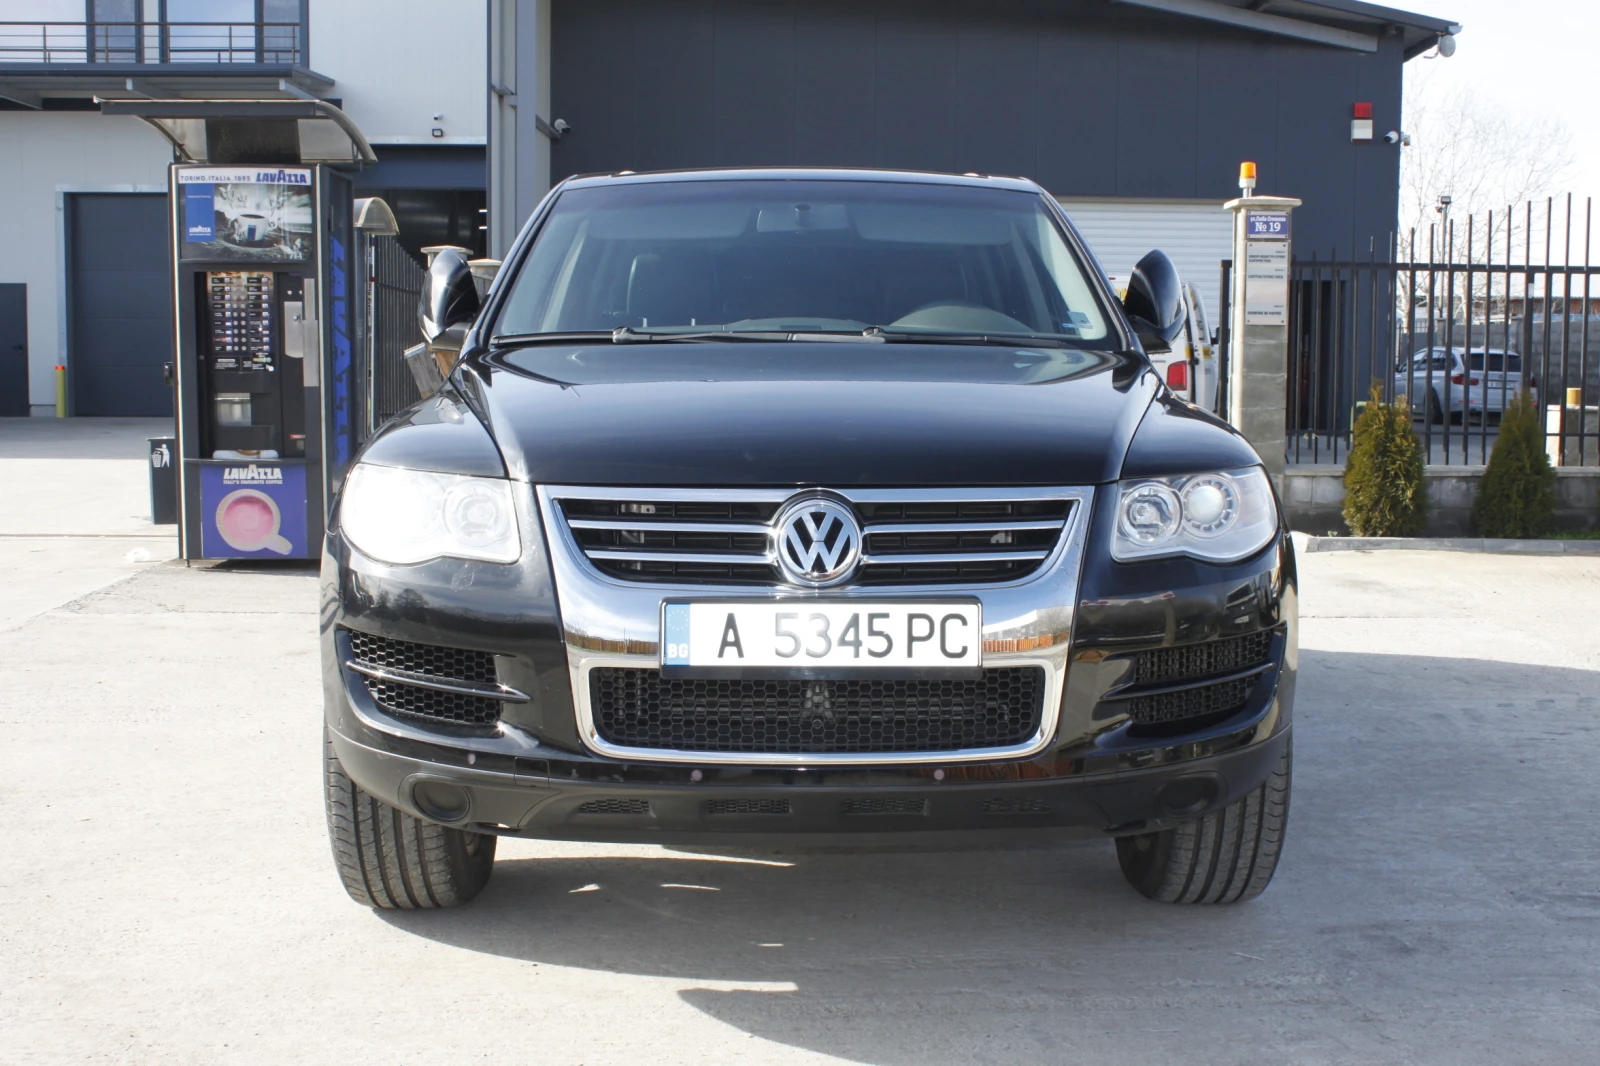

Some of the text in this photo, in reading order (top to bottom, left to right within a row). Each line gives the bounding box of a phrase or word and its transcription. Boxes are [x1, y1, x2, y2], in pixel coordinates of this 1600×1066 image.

[256, 169, 307, 183] LAVAZZA
[1269, 221, 1281, 232] 19
[332, 238, 352, 467] LAVAZZA
[223, 464, 283, 480] LAVAZZA
[717, 612, 745, 659] A
[667, 643, 689, 658] BG
